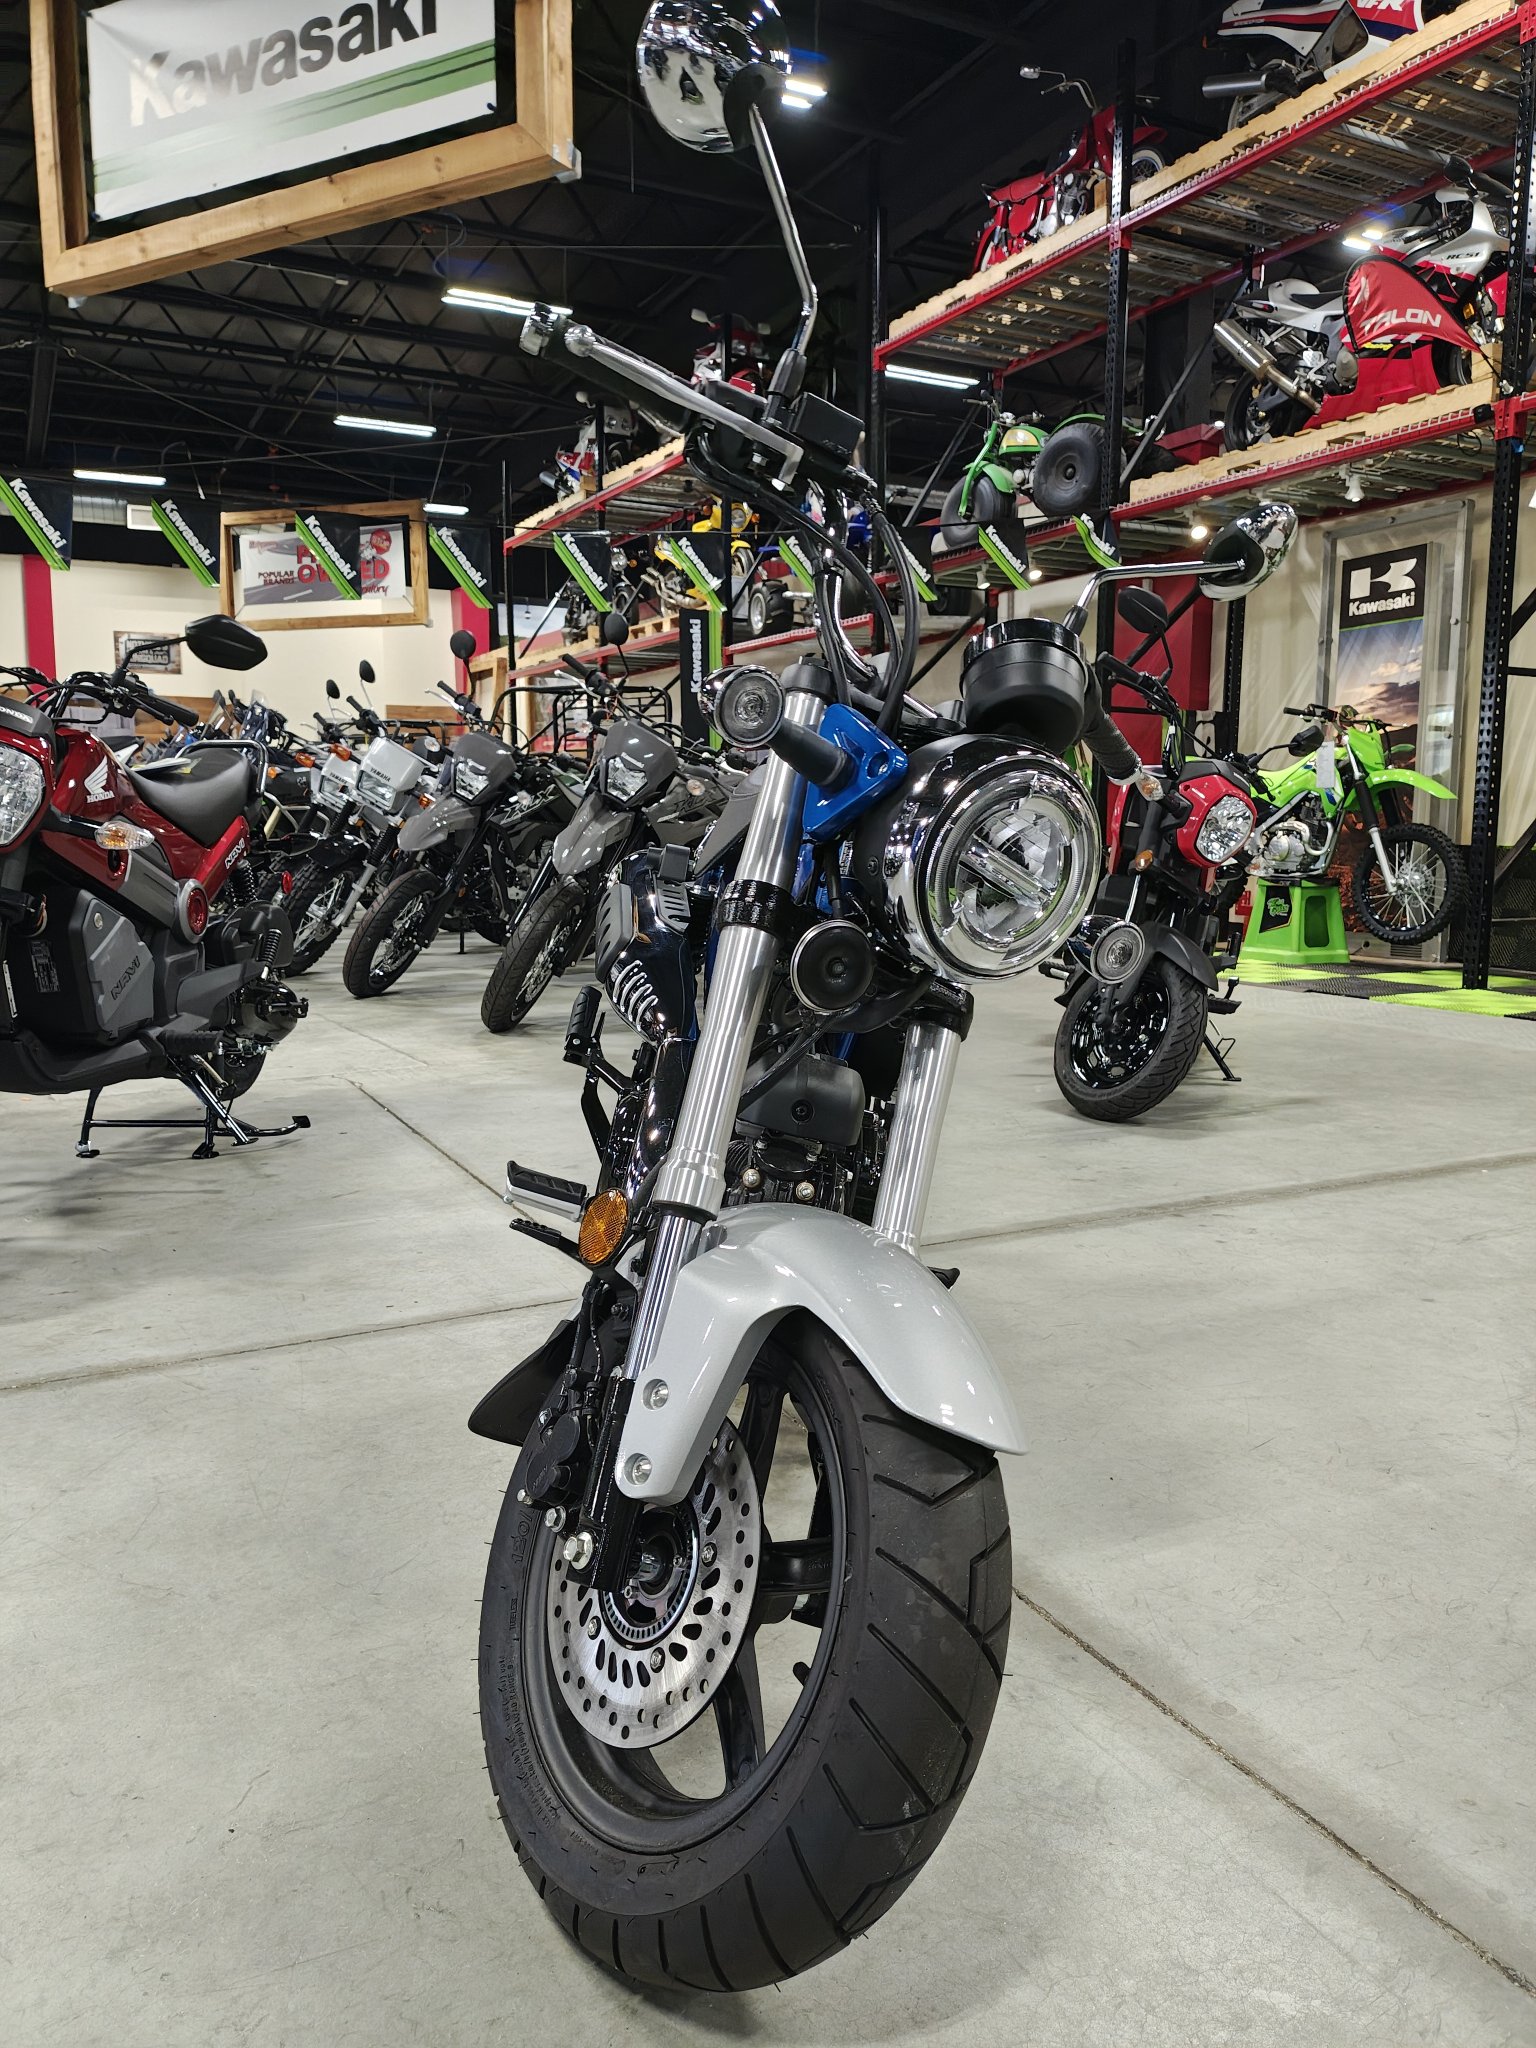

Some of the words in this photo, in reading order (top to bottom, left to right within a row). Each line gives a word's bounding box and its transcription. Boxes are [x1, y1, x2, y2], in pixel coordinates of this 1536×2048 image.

[130, 0, 438, 127] Kawasaki
[1360, 308, 1442, 336] TALON
[9, 477, 67, 549] Kawasaki
[161, 499, 217, 566] Kawasaki
[304, 514, 357, 580] Kawasaki
[437, 526, 488, 588] Kawasaki
[561, 532, 609, 592] Kawasaki
[678, 536, 722, 591] Kawasaki
[786, 535, 813, 575] Kawa
[985, 524, 1027, 574] Kawasaki
[258, 570, 294, 579] POPULAR
[263, 577, 295, 586] BRANDS
[1348, 591, 1416, 617] Kawasaki
[689, 618, 702, 693] Kawasaki
[0, 706, 34, 724] ONDA
[329, 772, 348, 784] YAMAHA
[370, 767, 391, 782] YAMAHA
[86, 790, 115, 803] HONDA
[224, 837, 246, 870] NAVI
[110, 955, 142, 1001] NAVI
